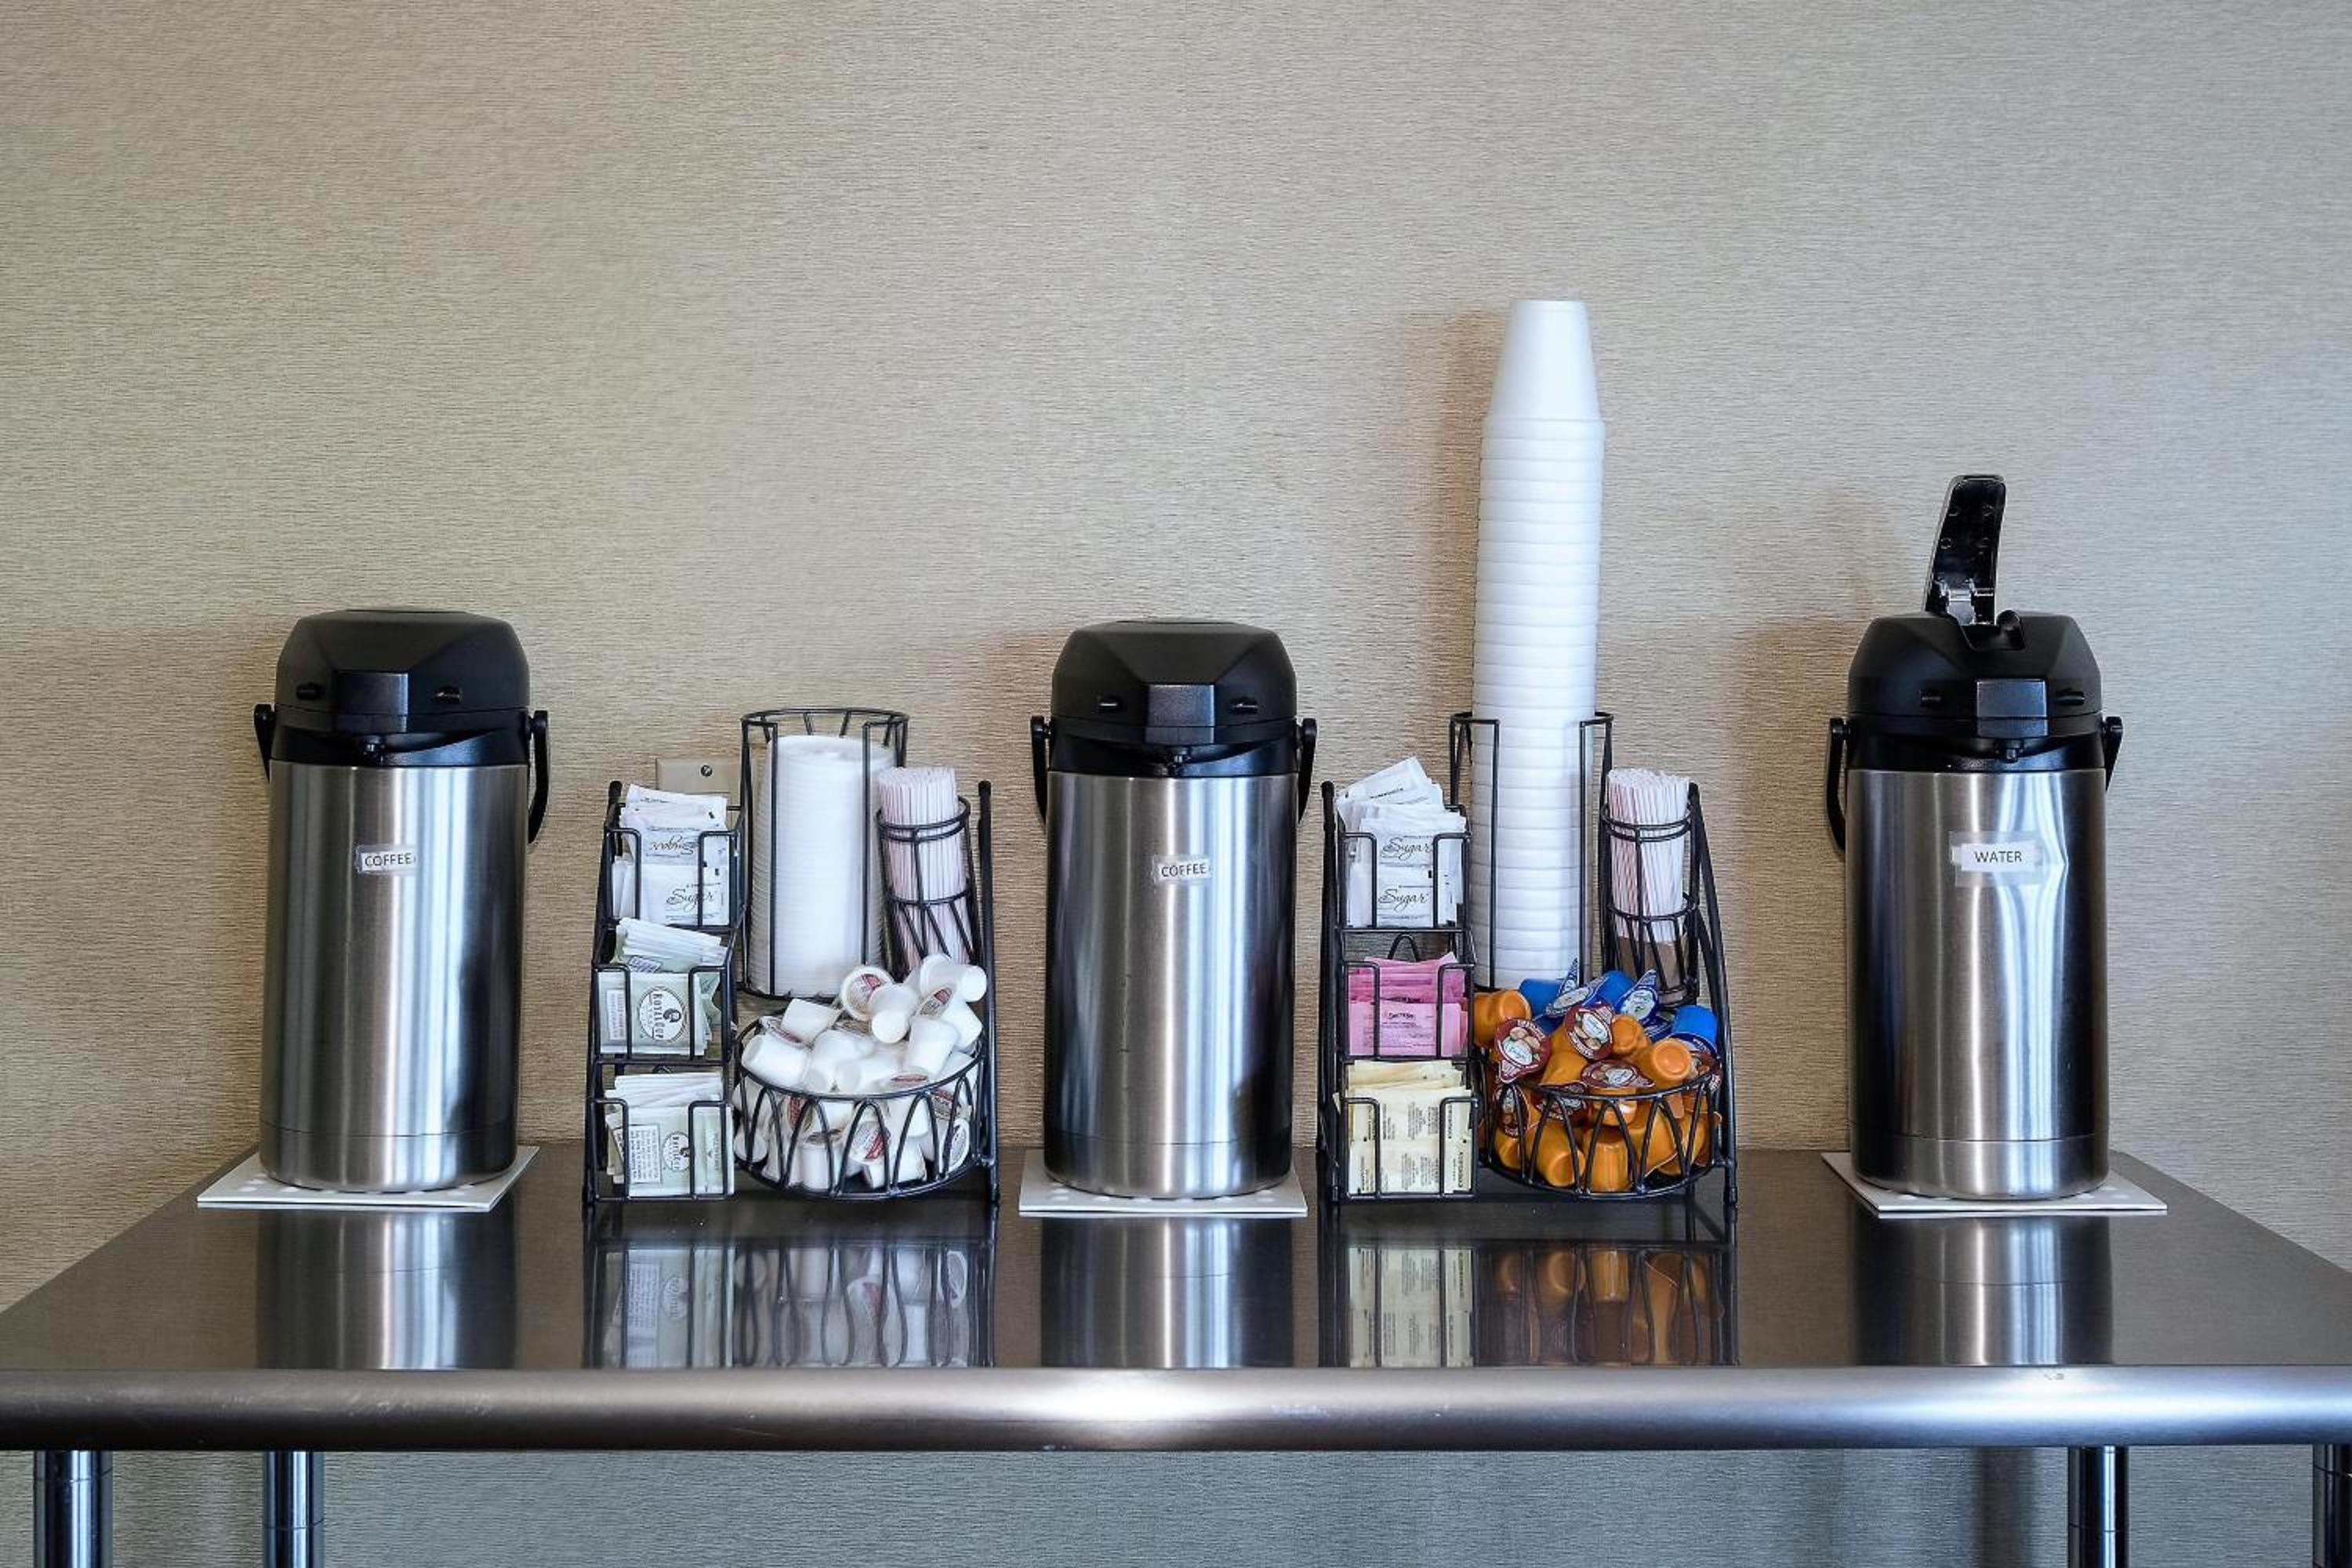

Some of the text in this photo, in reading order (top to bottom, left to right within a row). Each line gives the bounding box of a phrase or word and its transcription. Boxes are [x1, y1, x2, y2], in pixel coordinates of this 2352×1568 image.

[365, 852, 412, 867] COFFEE
[1383, 837, 1431, 861] Sugar
[1973, 851, 2023, 863] WATER
[1161, 863, 1207, 877] COFFEE
[666, 888, 716, 913] Sugr
[1378, 888, 1429, 913] Sugar
[652, 993, 663, 1022] ROYAL
